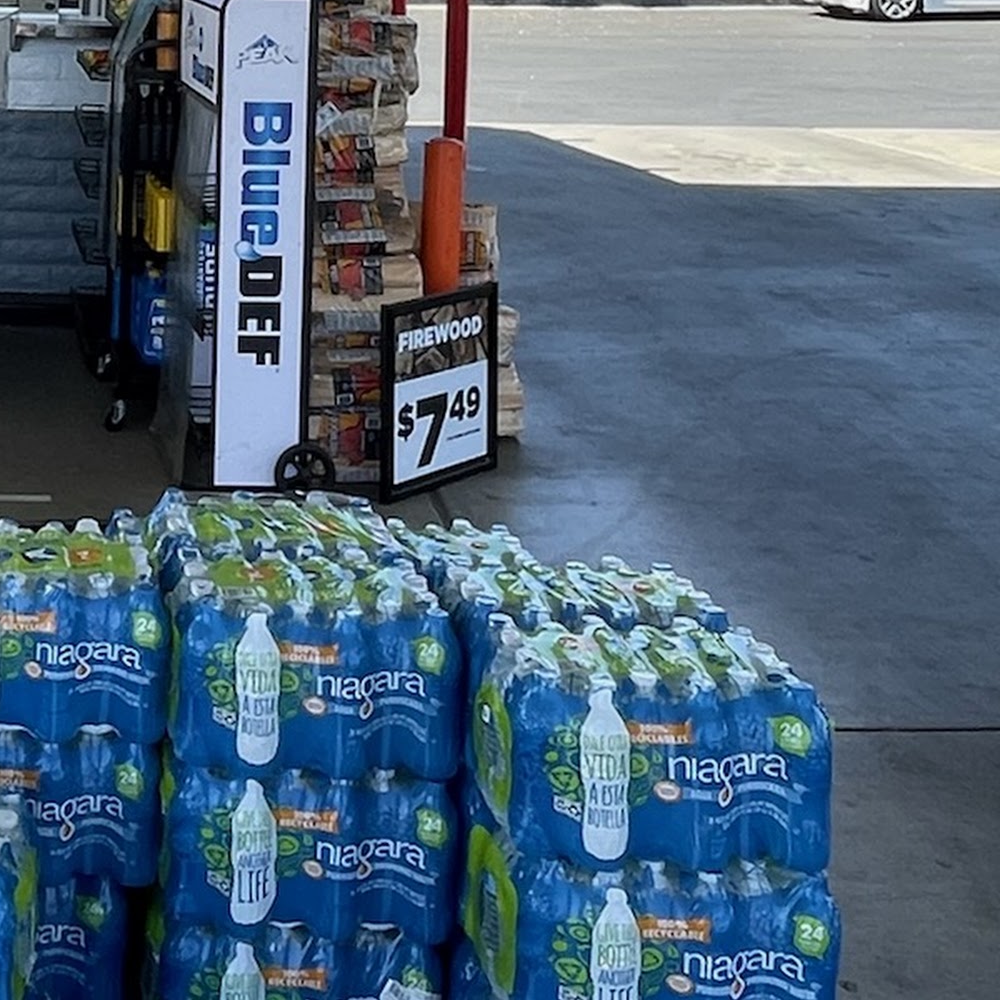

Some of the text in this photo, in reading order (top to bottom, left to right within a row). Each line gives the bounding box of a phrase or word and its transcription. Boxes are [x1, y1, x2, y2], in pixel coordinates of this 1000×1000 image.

[398, 314, 483, 353] FIREWOOD
[36, 641, 142, 680] niagara
[418, 642, 440, 658] 24
[240, 669, 278, 695] VIDA
[316, 671, 427, 720] niagara
[779, 722, 803, 739] 24
[118, 770, 138, 785] 24
[584, 752, 628, 781] VIDA
[668, 752, 789, 808] niagara
[25, 795, 125, 841] niagara
[422, 818, 442, 832] 24
[316, 838, 427, 880] niagara
[238, 866, 270, 904] LIFE
[800, 923, 825, 941] 24
[683, 949, 806, 1000] niagara
